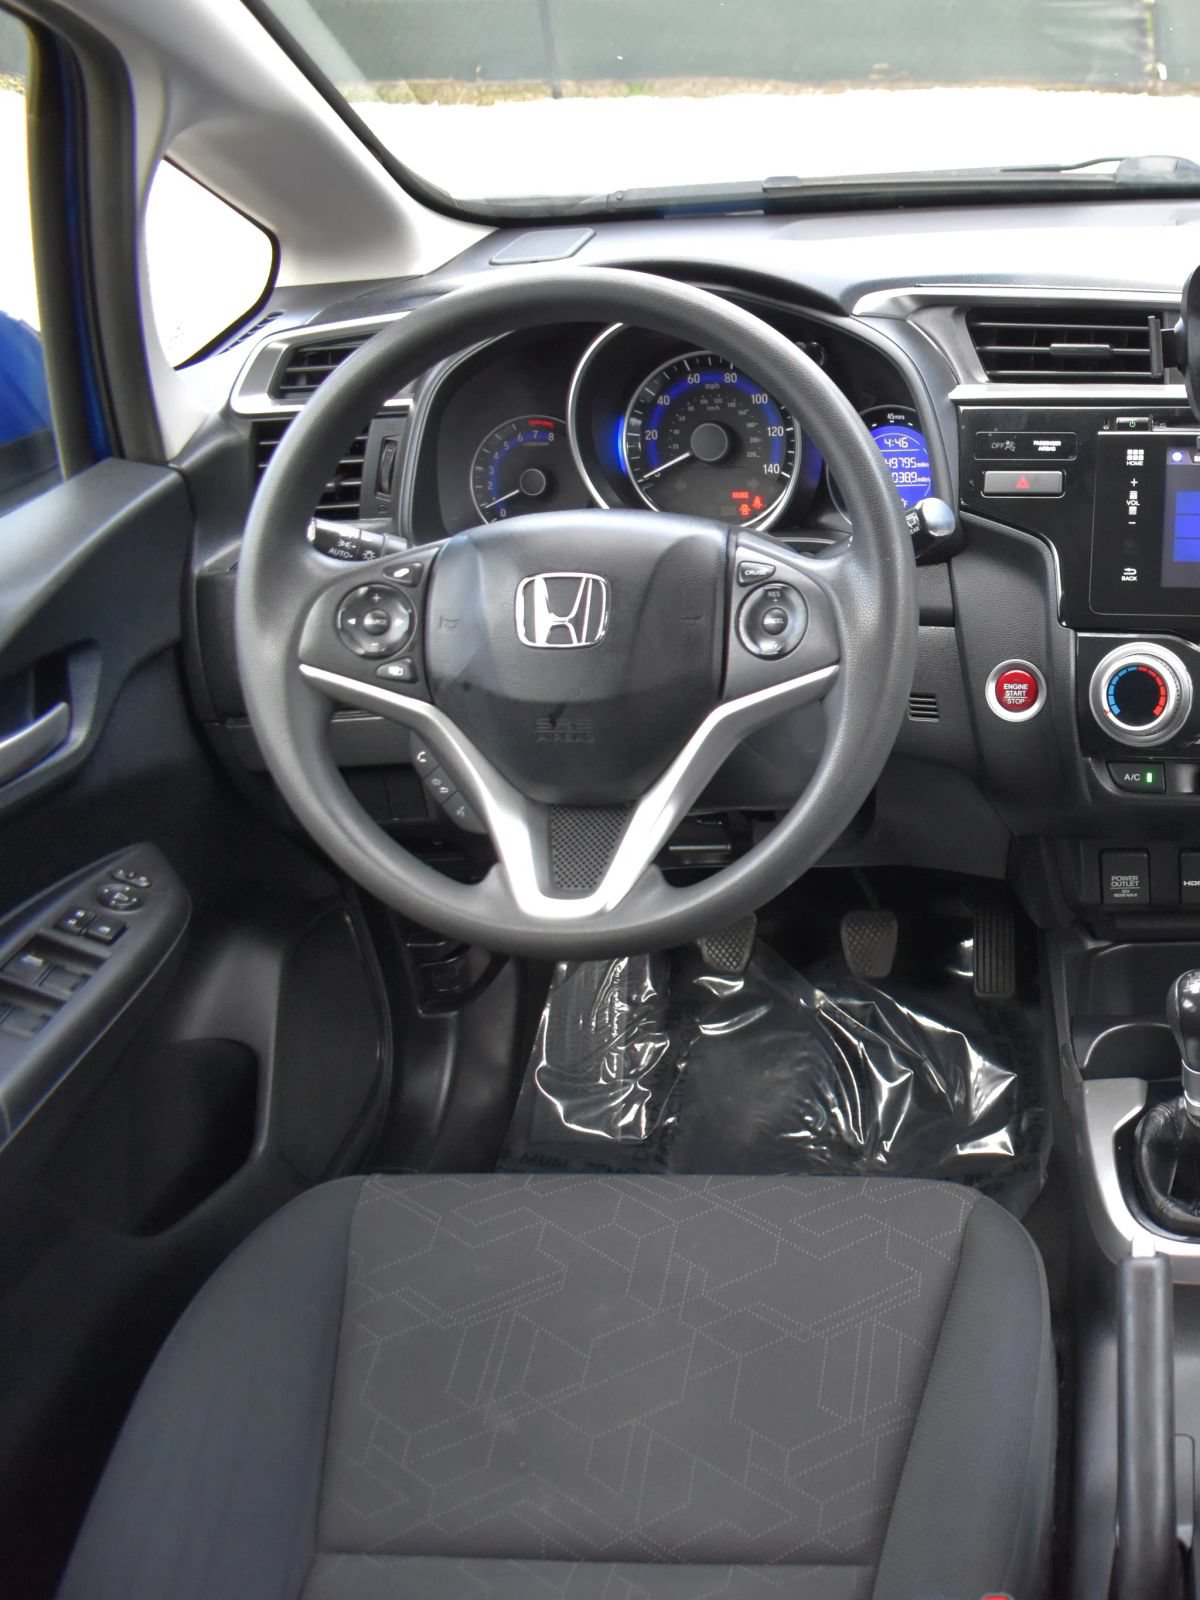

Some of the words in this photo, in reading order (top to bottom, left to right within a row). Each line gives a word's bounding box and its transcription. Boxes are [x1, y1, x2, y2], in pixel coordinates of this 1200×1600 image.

[687, 373, 700, 384] 60
[724, 373, 737, 383] 80
[657, 395, 670, 406] 40
[751, 393, 768, 404] 100
[533, 430, 539, 439] 7
[548, 433, 555, 441] 8
[645, 429, 658, 440] 20
[768, 426, 784, 437] 120
[517, 433, 524, 442] 6
[884, 437, 909, 448] 4:46
[504, 442, 510, 450] 5
[885, 457, 917, 468] 49795
[763, 463, 780, 474] 140
[488, 482, 494, 490] 2
[500, 509, 506, 517] 0
[328, 548, 352, 559] AUTO
